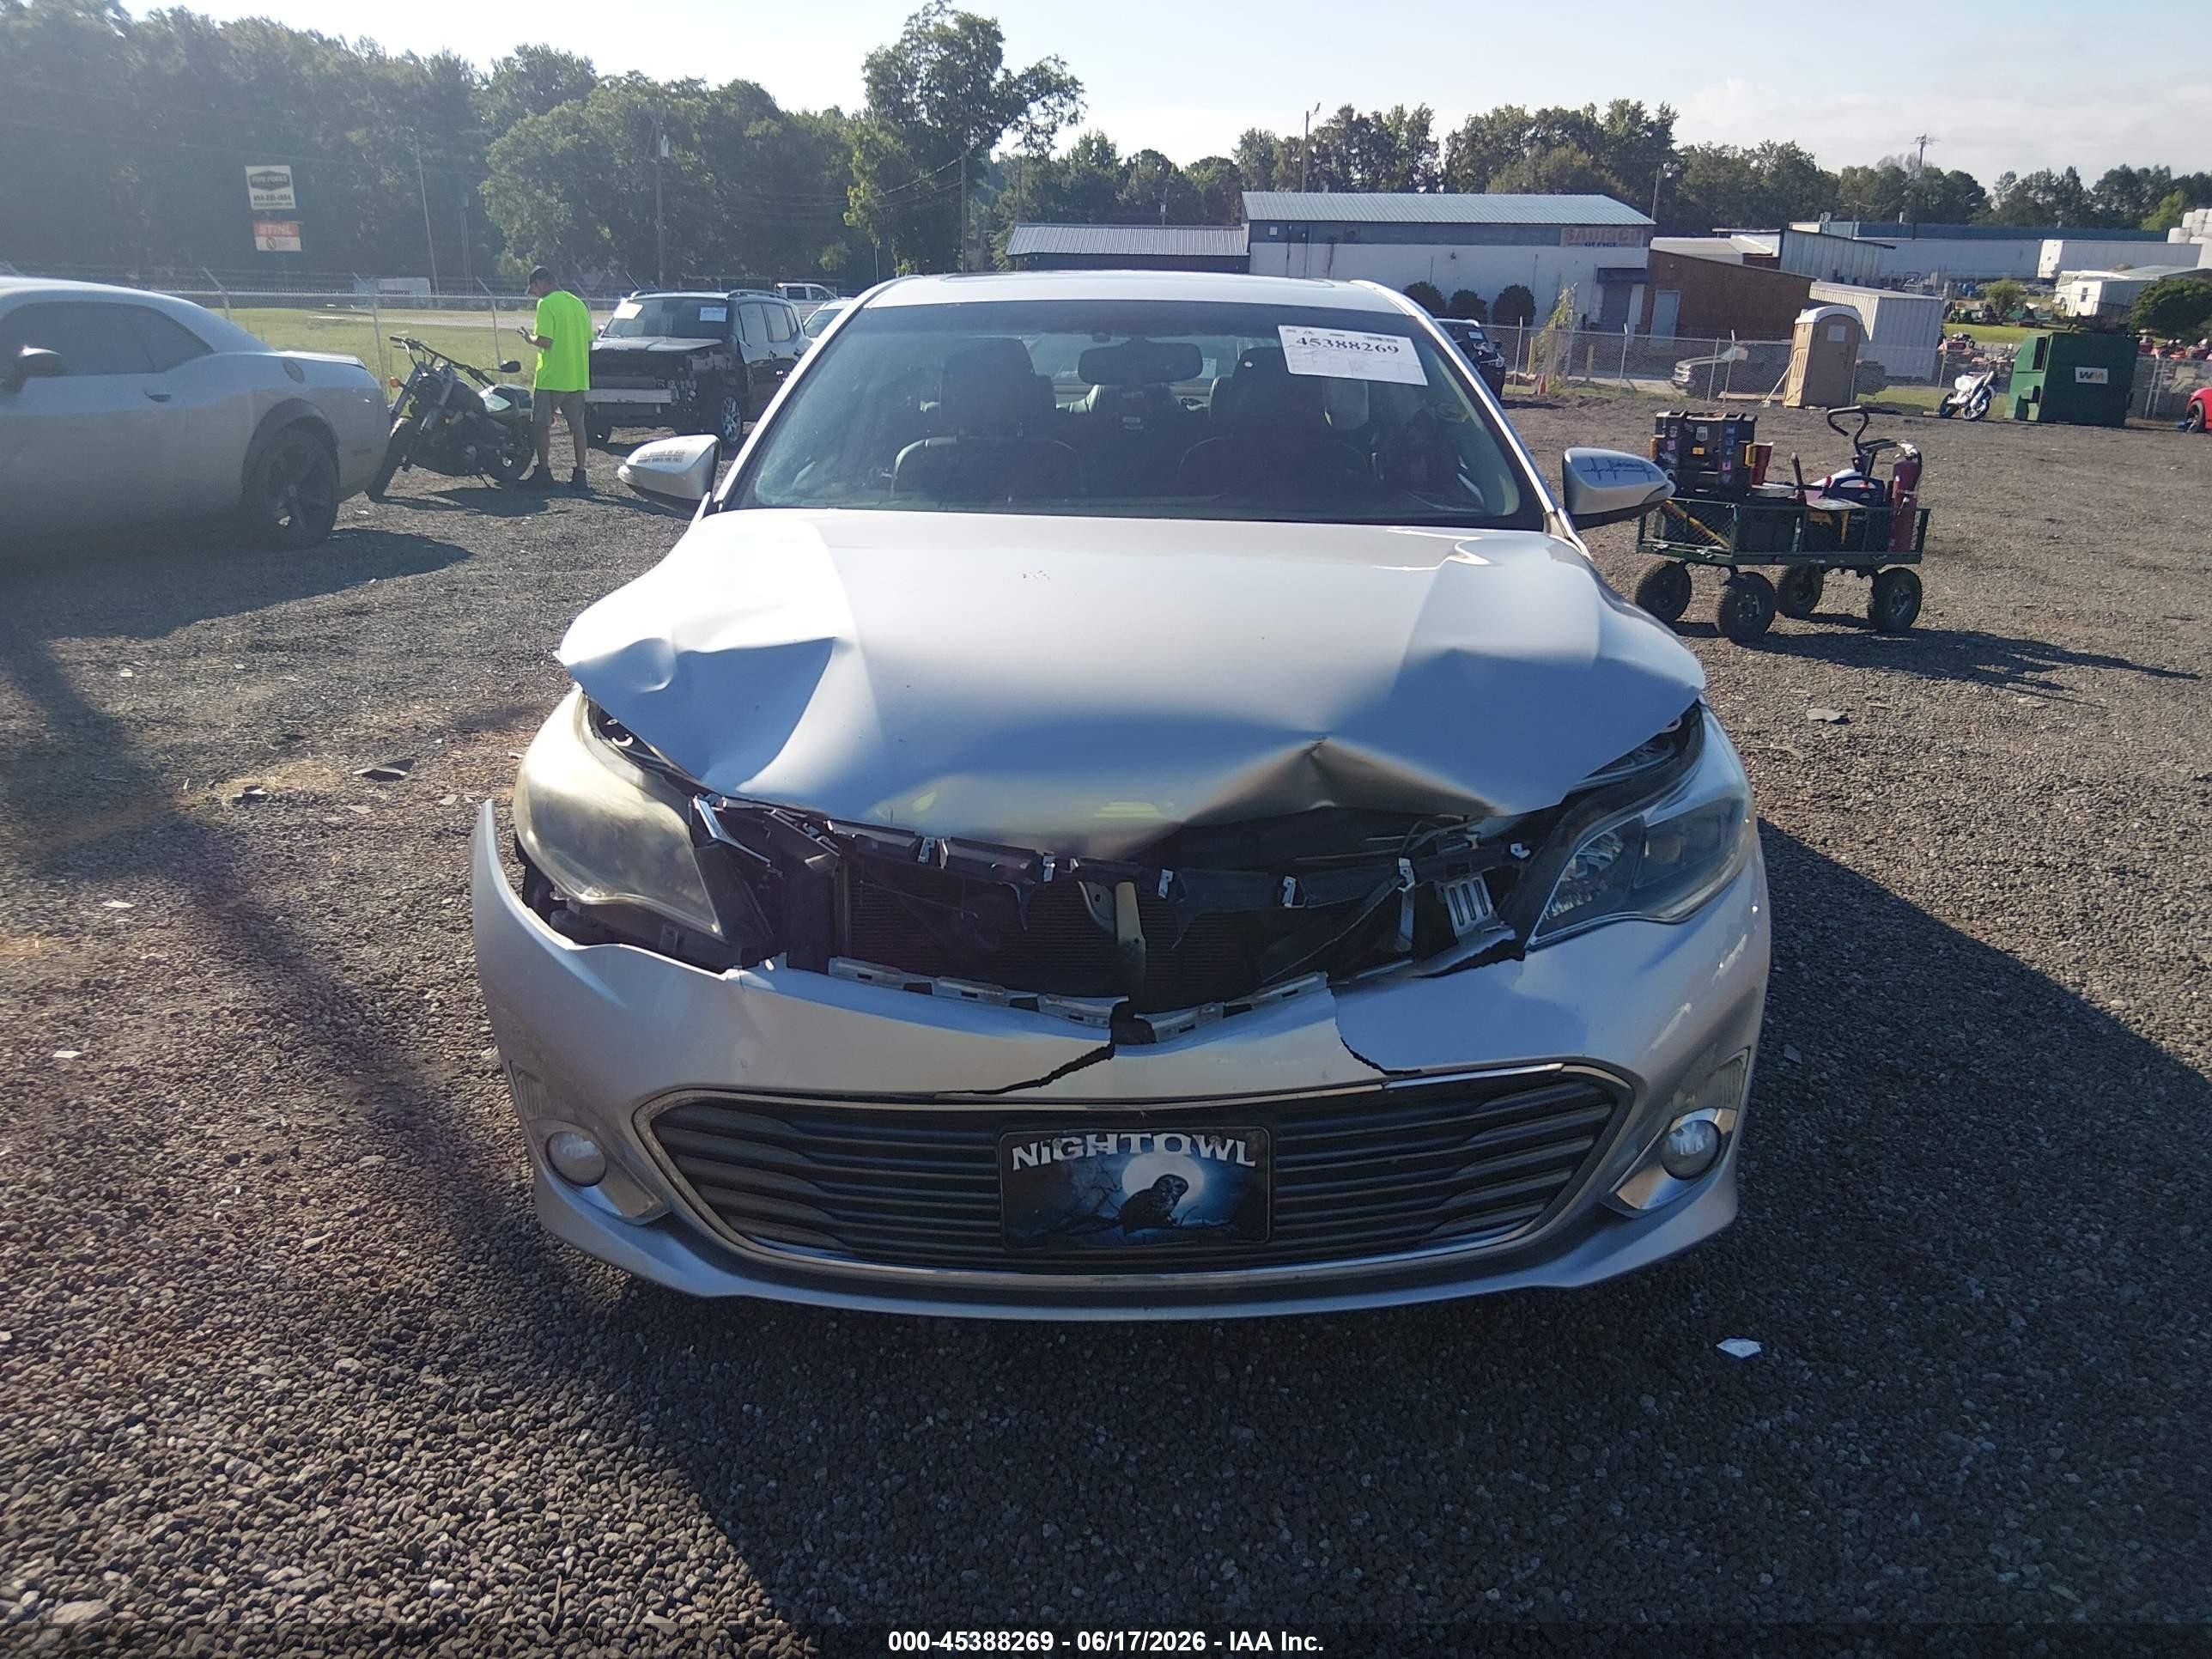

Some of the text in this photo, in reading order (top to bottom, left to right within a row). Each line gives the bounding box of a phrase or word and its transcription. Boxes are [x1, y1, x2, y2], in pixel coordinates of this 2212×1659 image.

[258, 224, 294, 235] STIHL
[1296, 337, 1400, 354] 45388269
[2079, 371, 2104, 380] WM
[1012, 1133, 1256, 1170] NIGHTOWL
